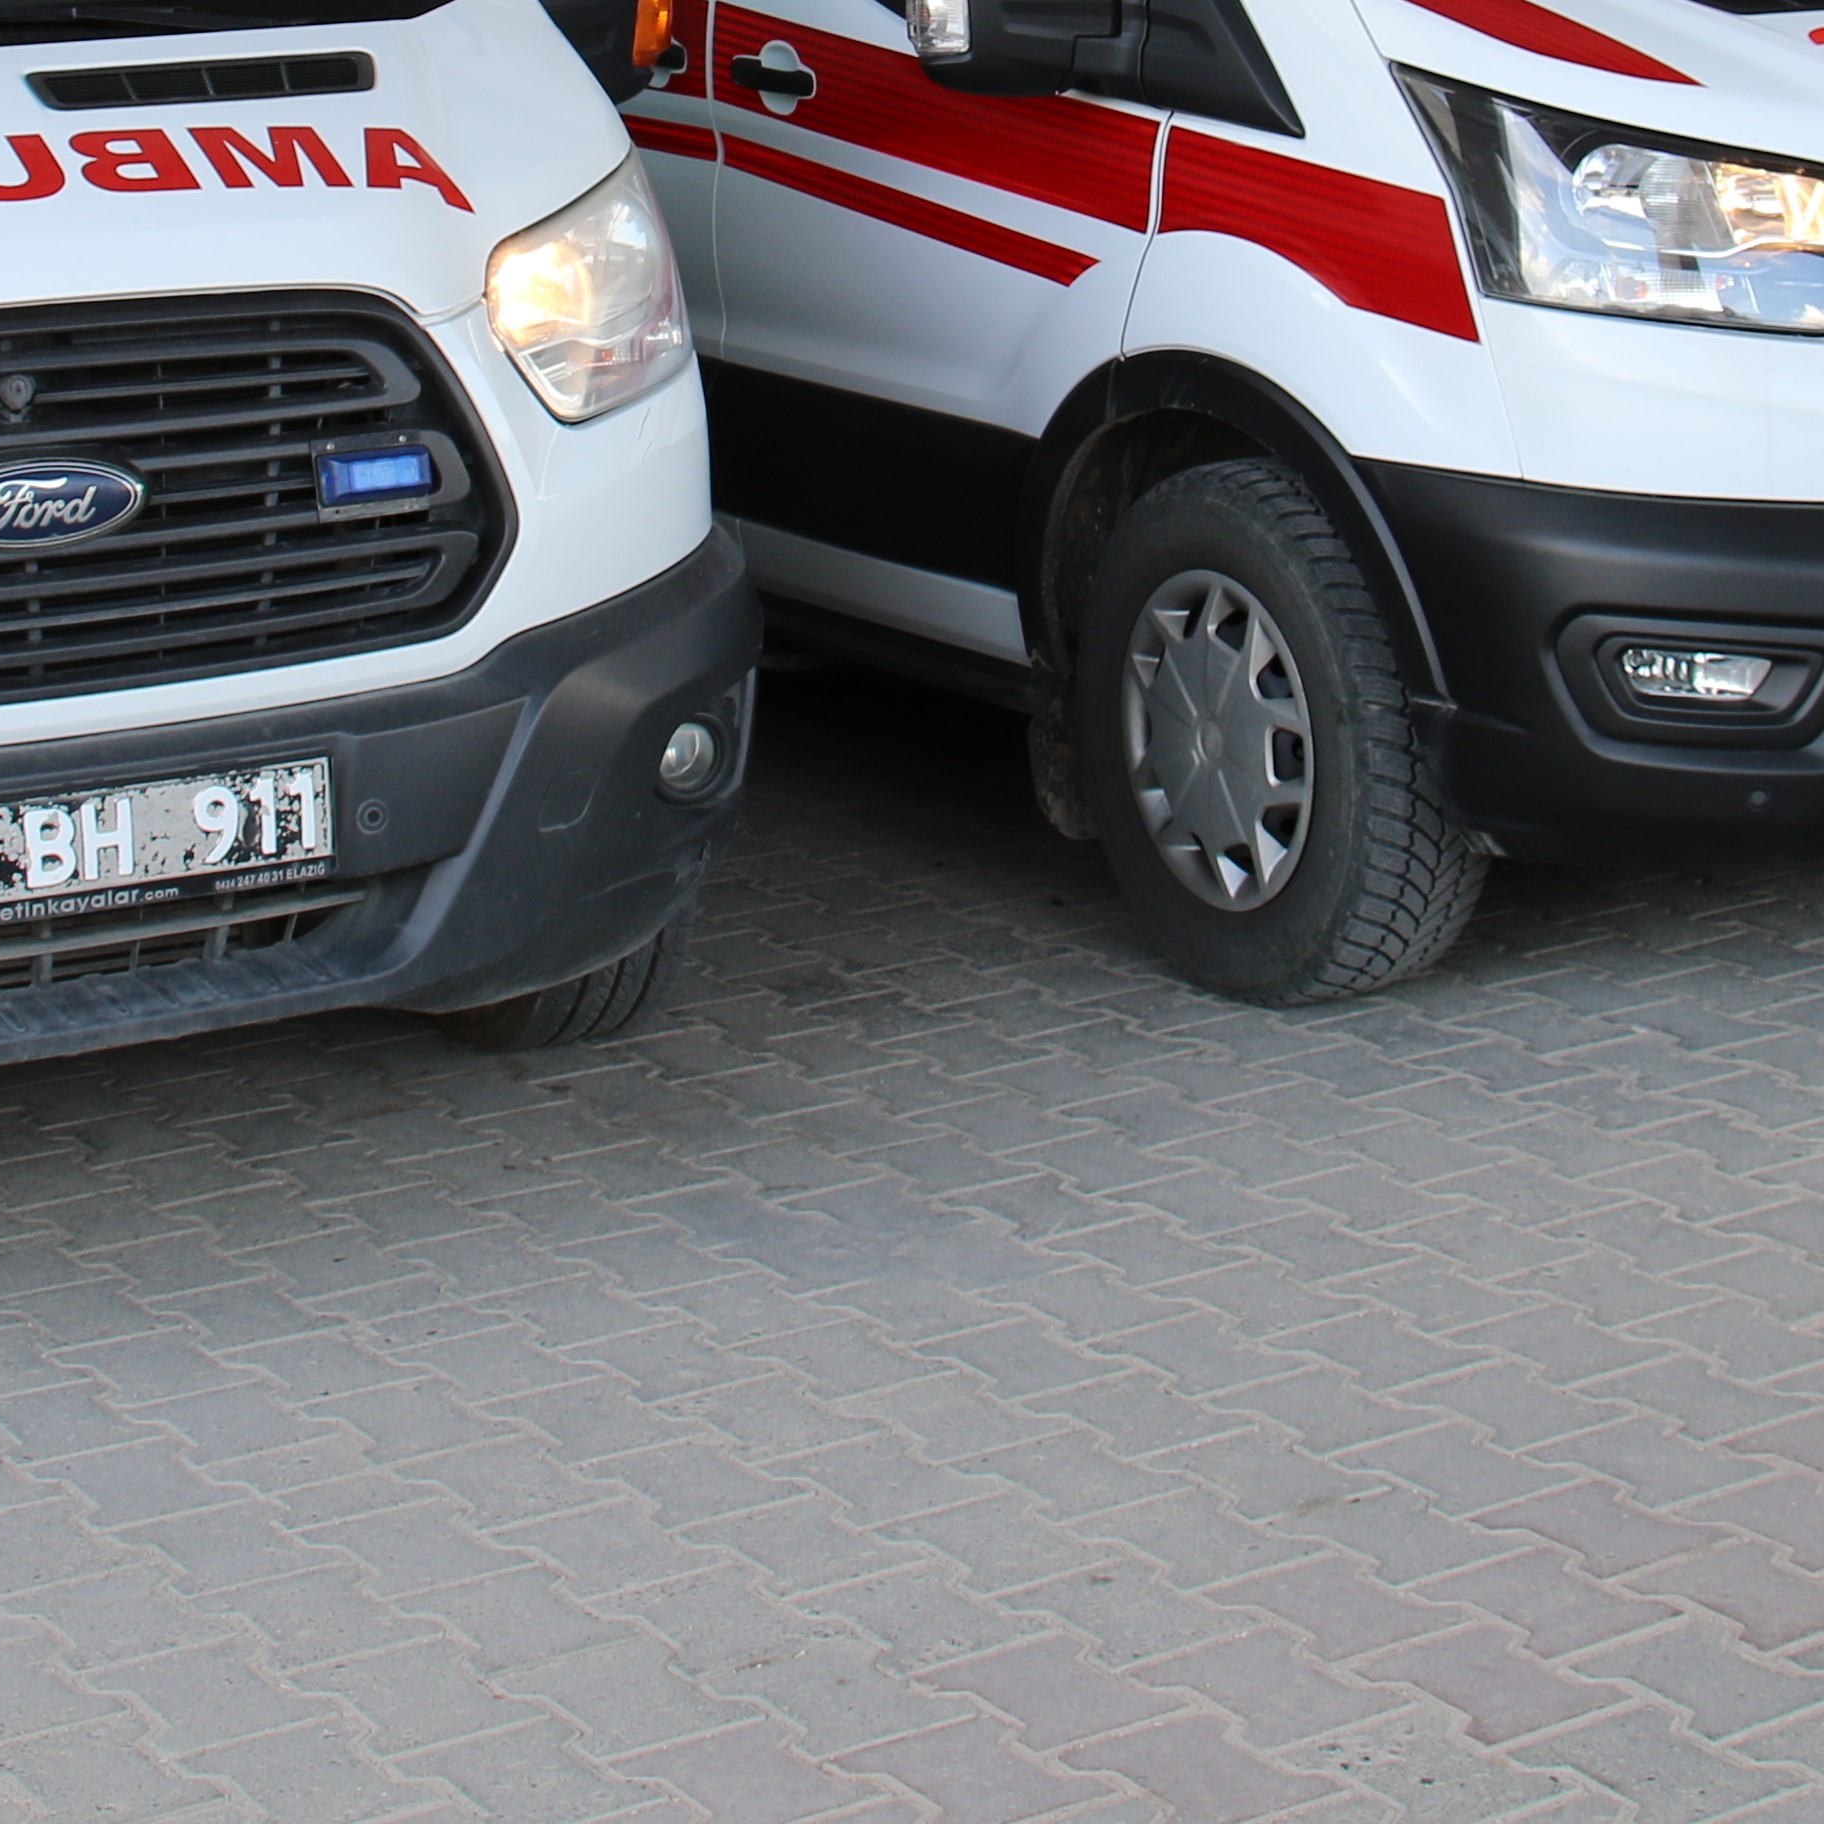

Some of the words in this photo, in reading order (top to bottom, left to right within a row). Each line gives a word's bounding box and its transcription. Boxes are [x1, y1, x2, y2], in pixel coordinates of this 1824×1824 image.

[23, 796, 136, 890] BH
[192, 767, 316, 865] 911
[236, 873, 255, 888] 247
[256, 872, 270, 884] 40
[271, 870, 284, 883] 31
